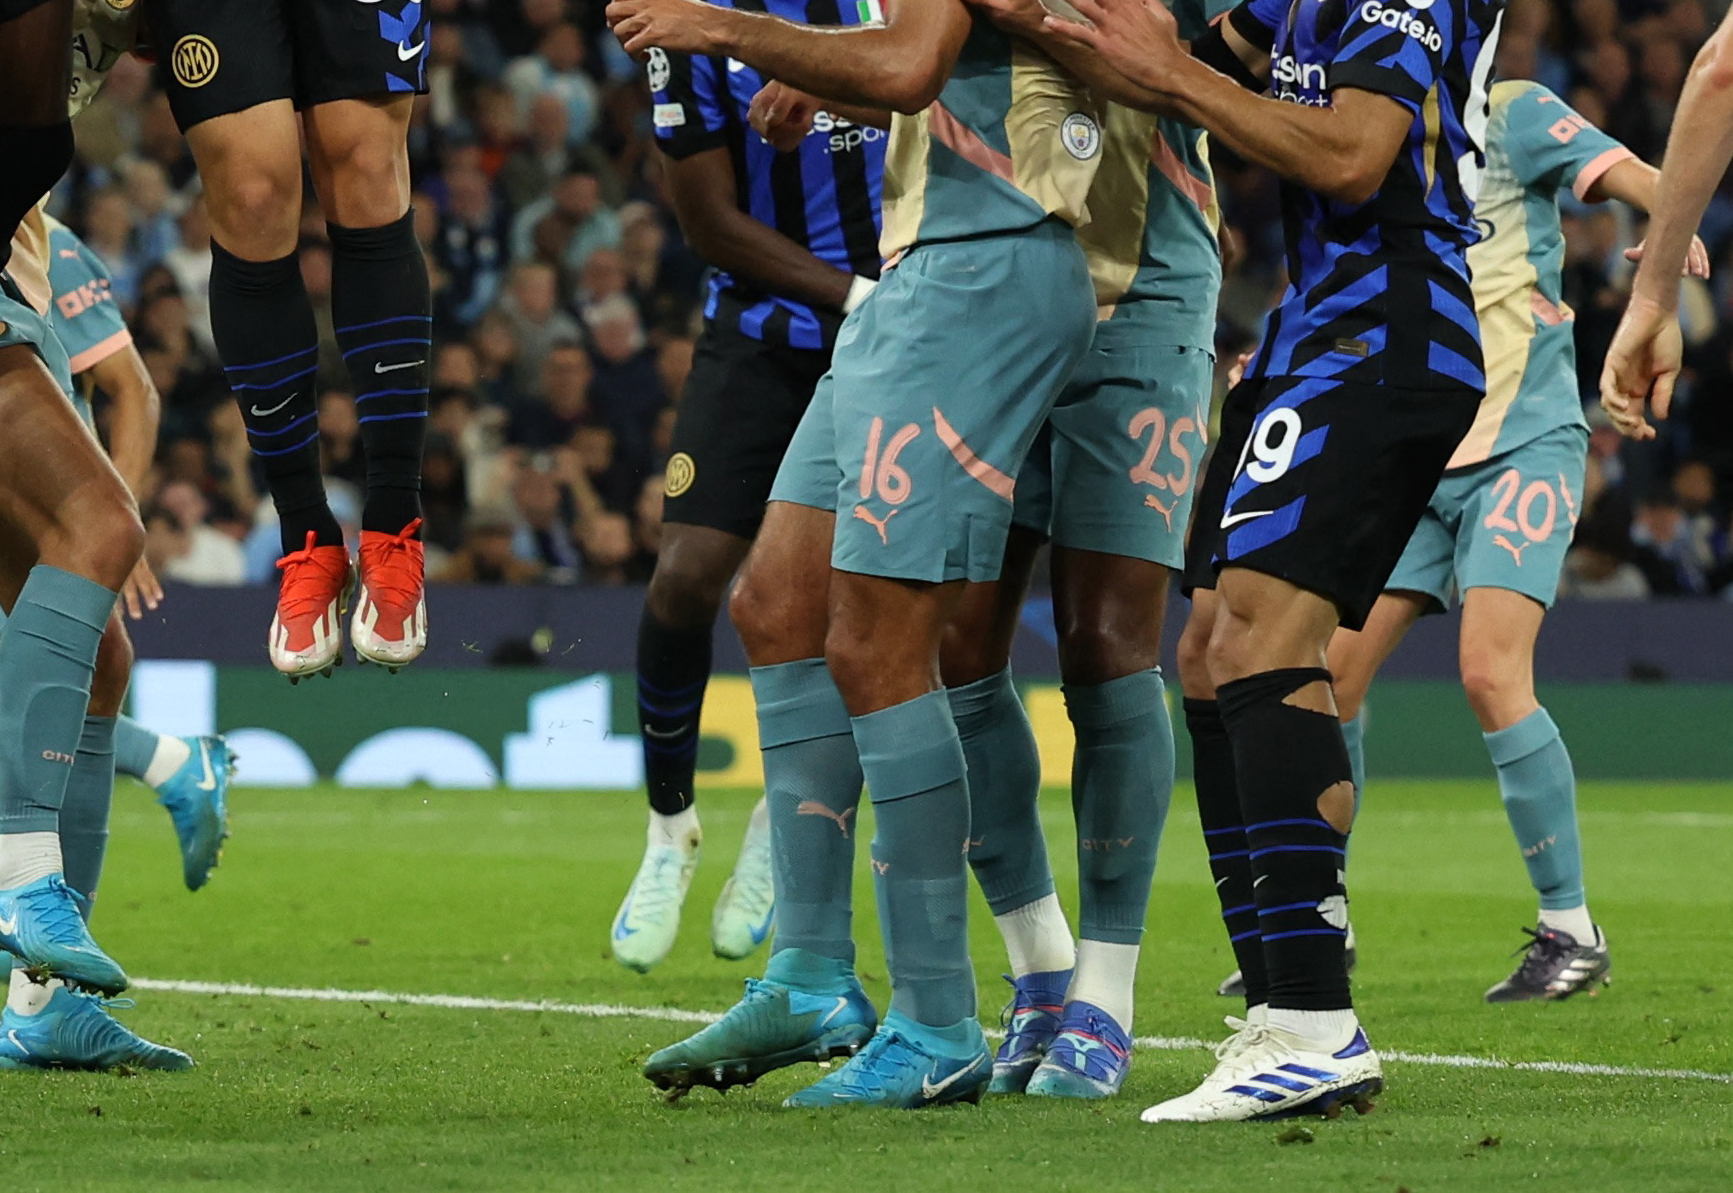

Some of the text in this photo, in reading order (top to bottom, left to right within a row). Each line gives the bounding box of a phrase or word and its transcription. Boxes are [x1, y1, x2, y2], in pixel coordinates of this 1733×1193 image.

[1361, 0, 1442, 52] Gate.io
[859, 416, 921, 504] 16
[1128, 407, 1195, 496] 25
[1232, 406, 1302, 484] 9
[1484, 468, 1557, 542] 20
